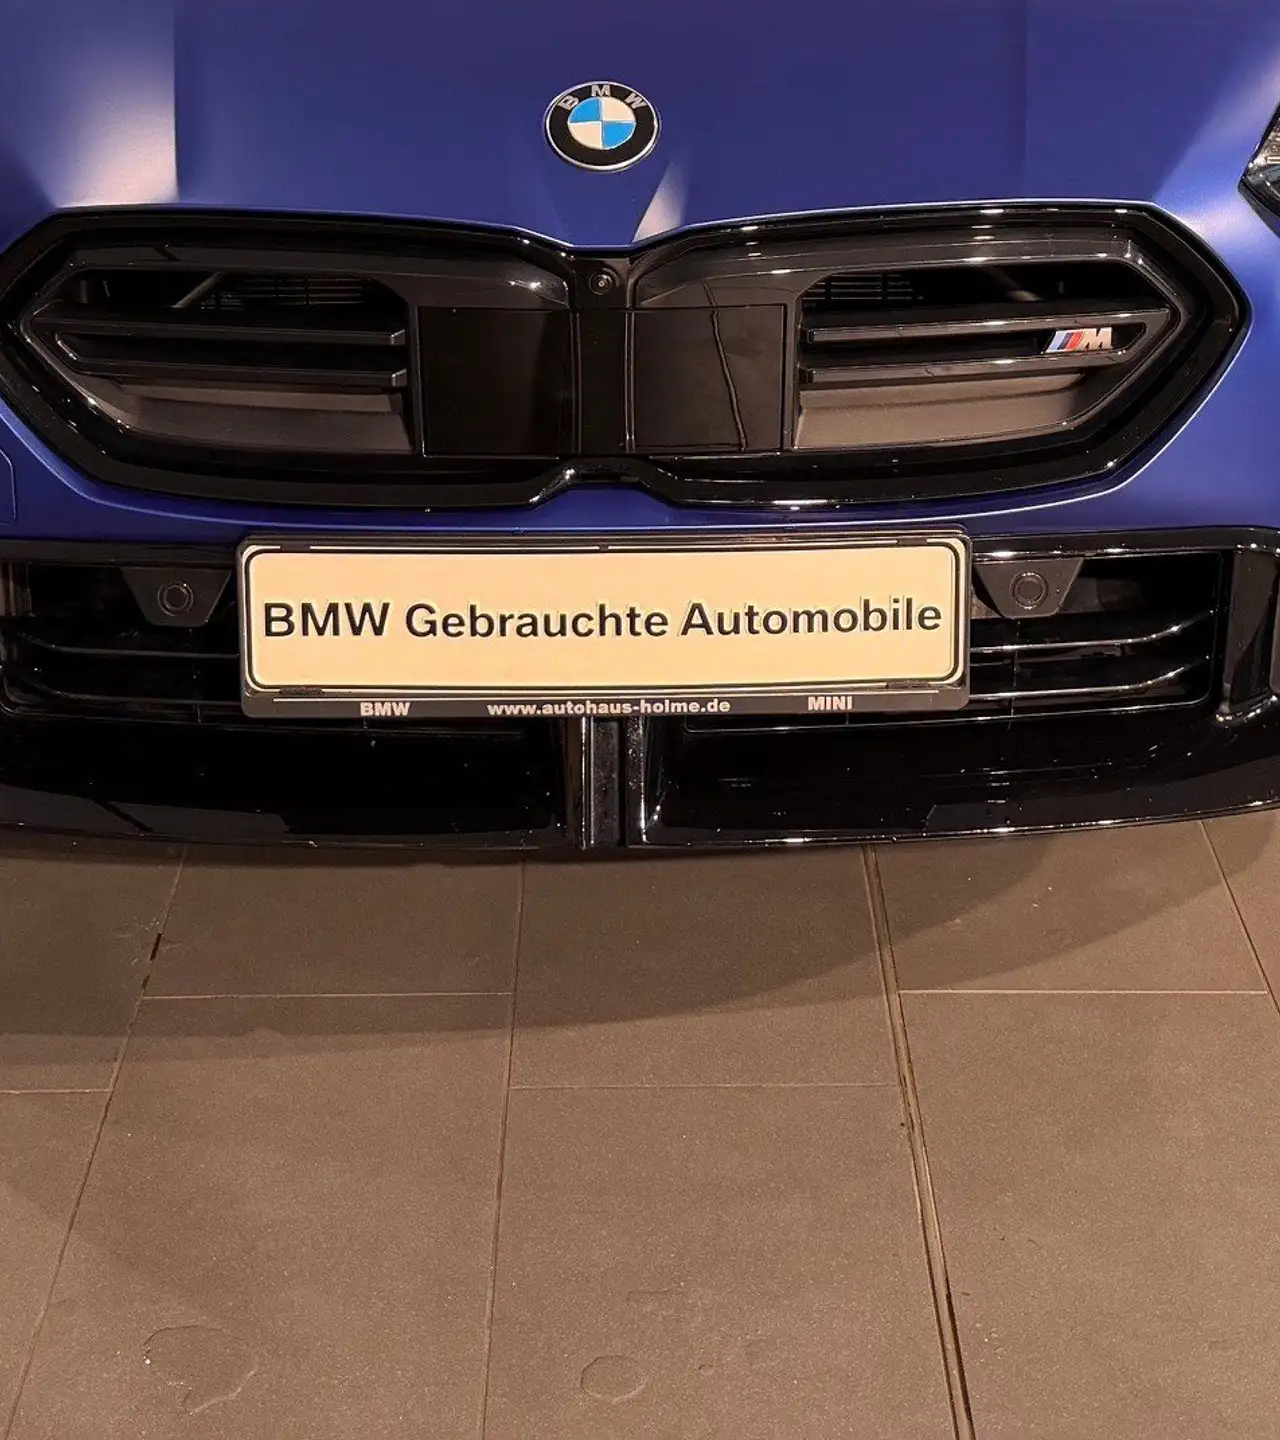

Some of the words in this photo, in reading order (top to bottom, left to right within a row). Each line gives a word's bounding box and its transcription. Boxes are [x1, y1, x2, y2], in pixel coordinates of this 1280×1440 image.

[557, 84, 649, 112] BMW
[264, 602, 391, 637] BMW
[405, 602, 669, 639] Gebrauchte
[679, 596, 942, 637] Automobile
[359, 701, 411, 717] BMW
[486, 697, 732, 717] www.autohaus-holme.de
[807, 695, 853, 711] MINI
